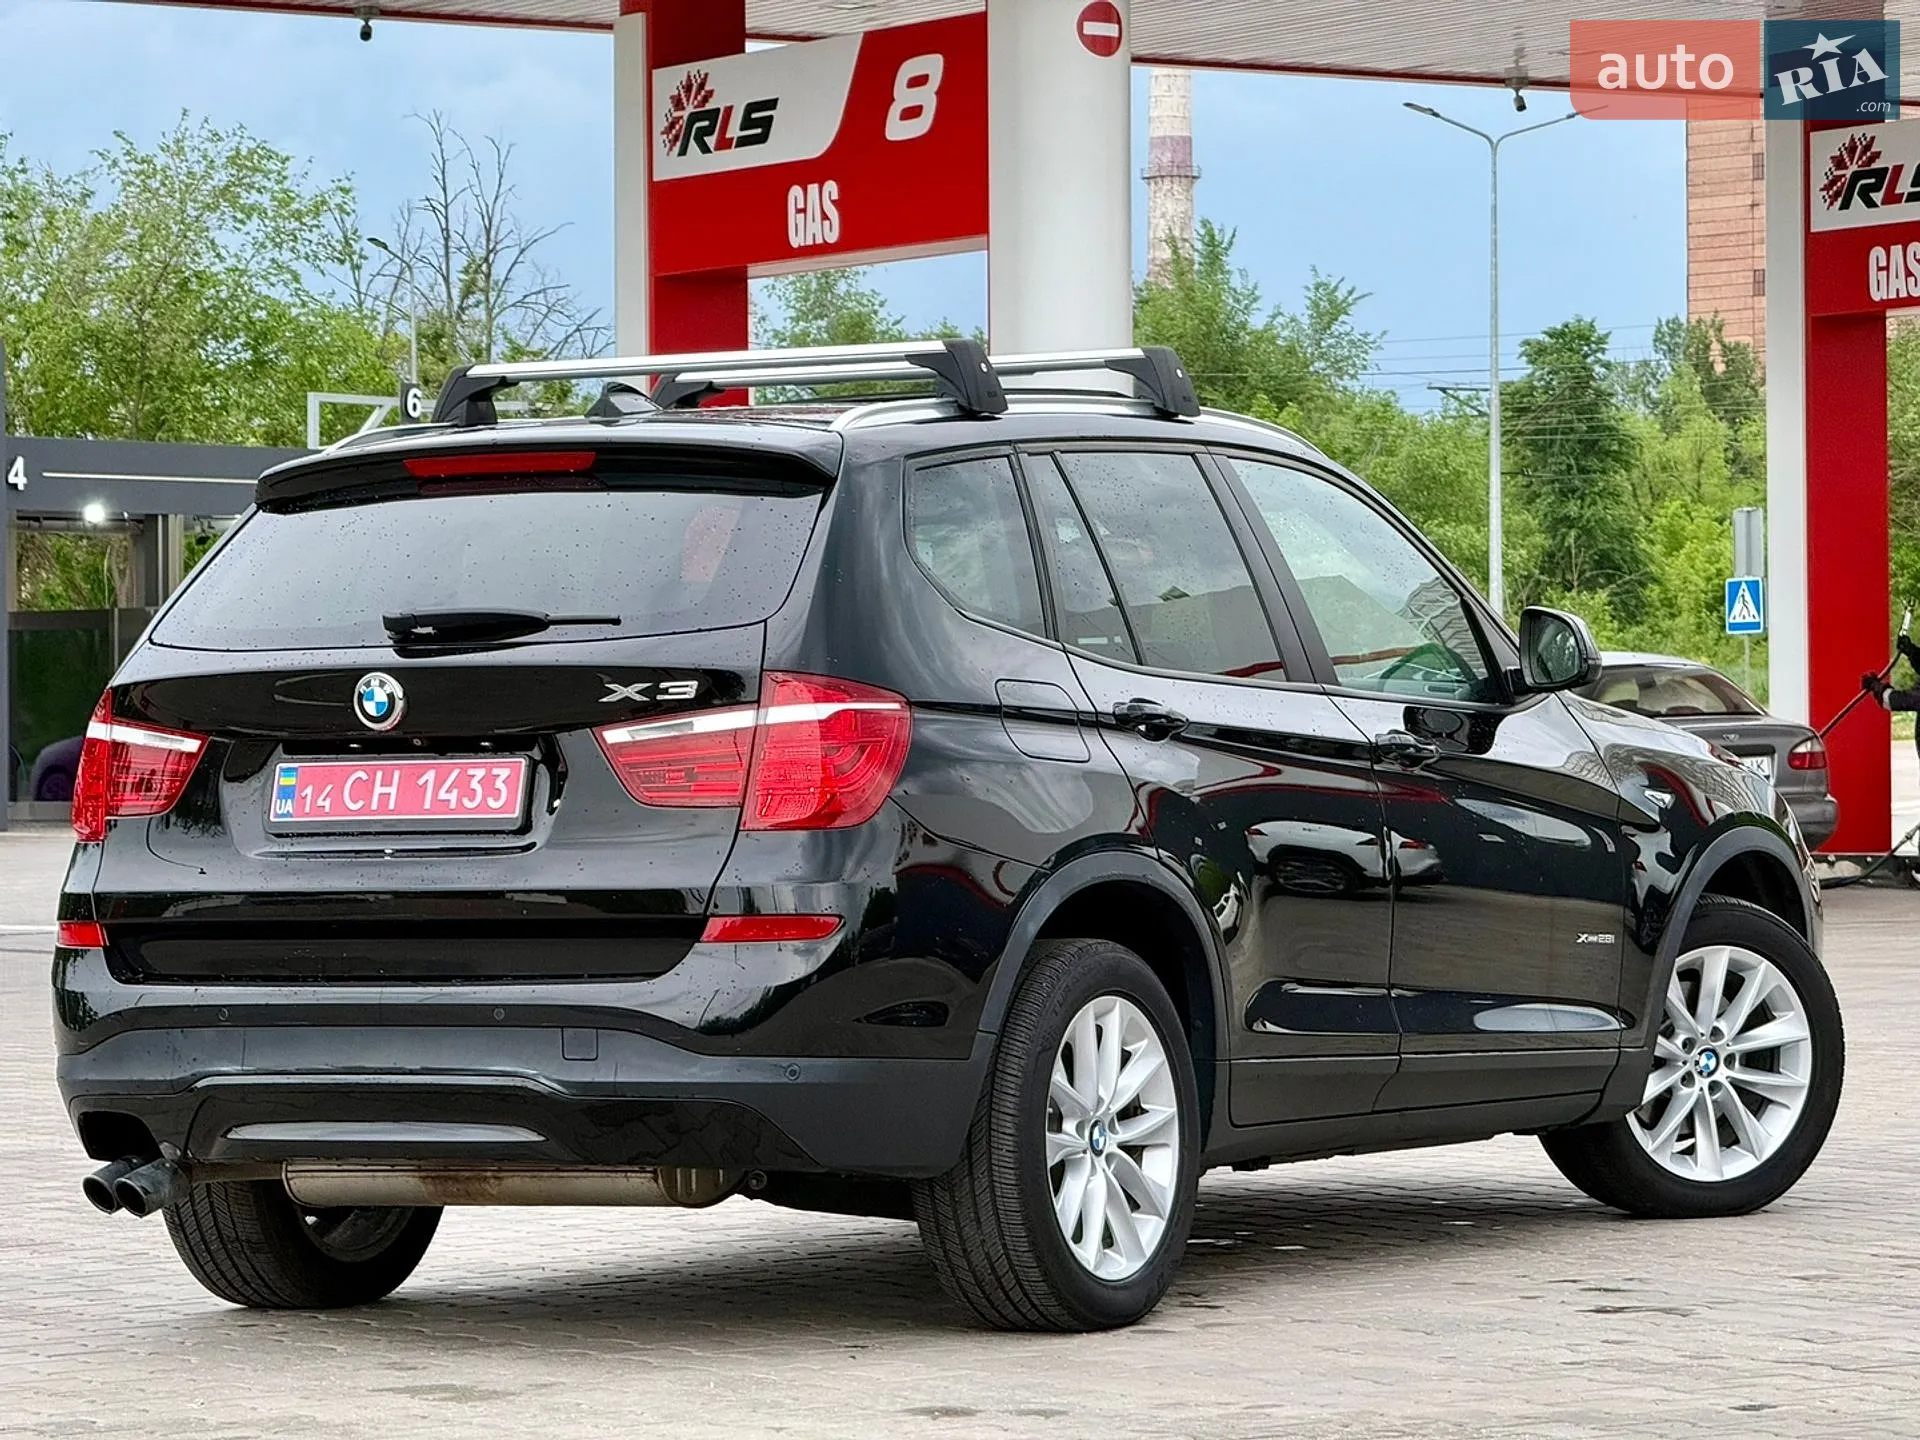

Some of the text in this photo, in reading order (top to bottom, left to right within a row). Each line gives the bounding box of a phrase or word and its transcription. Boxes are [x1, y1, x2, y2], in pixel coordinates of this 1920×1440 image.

[884, 53, 945, 142] 8
[677, 97, 780, 158] RLS
[787, 179, 840, 249] GAS
[1868, 240, 1920, 302] GAS
[406, 387, 422, 418] 6
[7, 455, 28, 491] 4
[598, 680, 699, 703] X3
[275, 799, 294, 815] UA
[300, 767, 512, 814] 14 CH 1433
